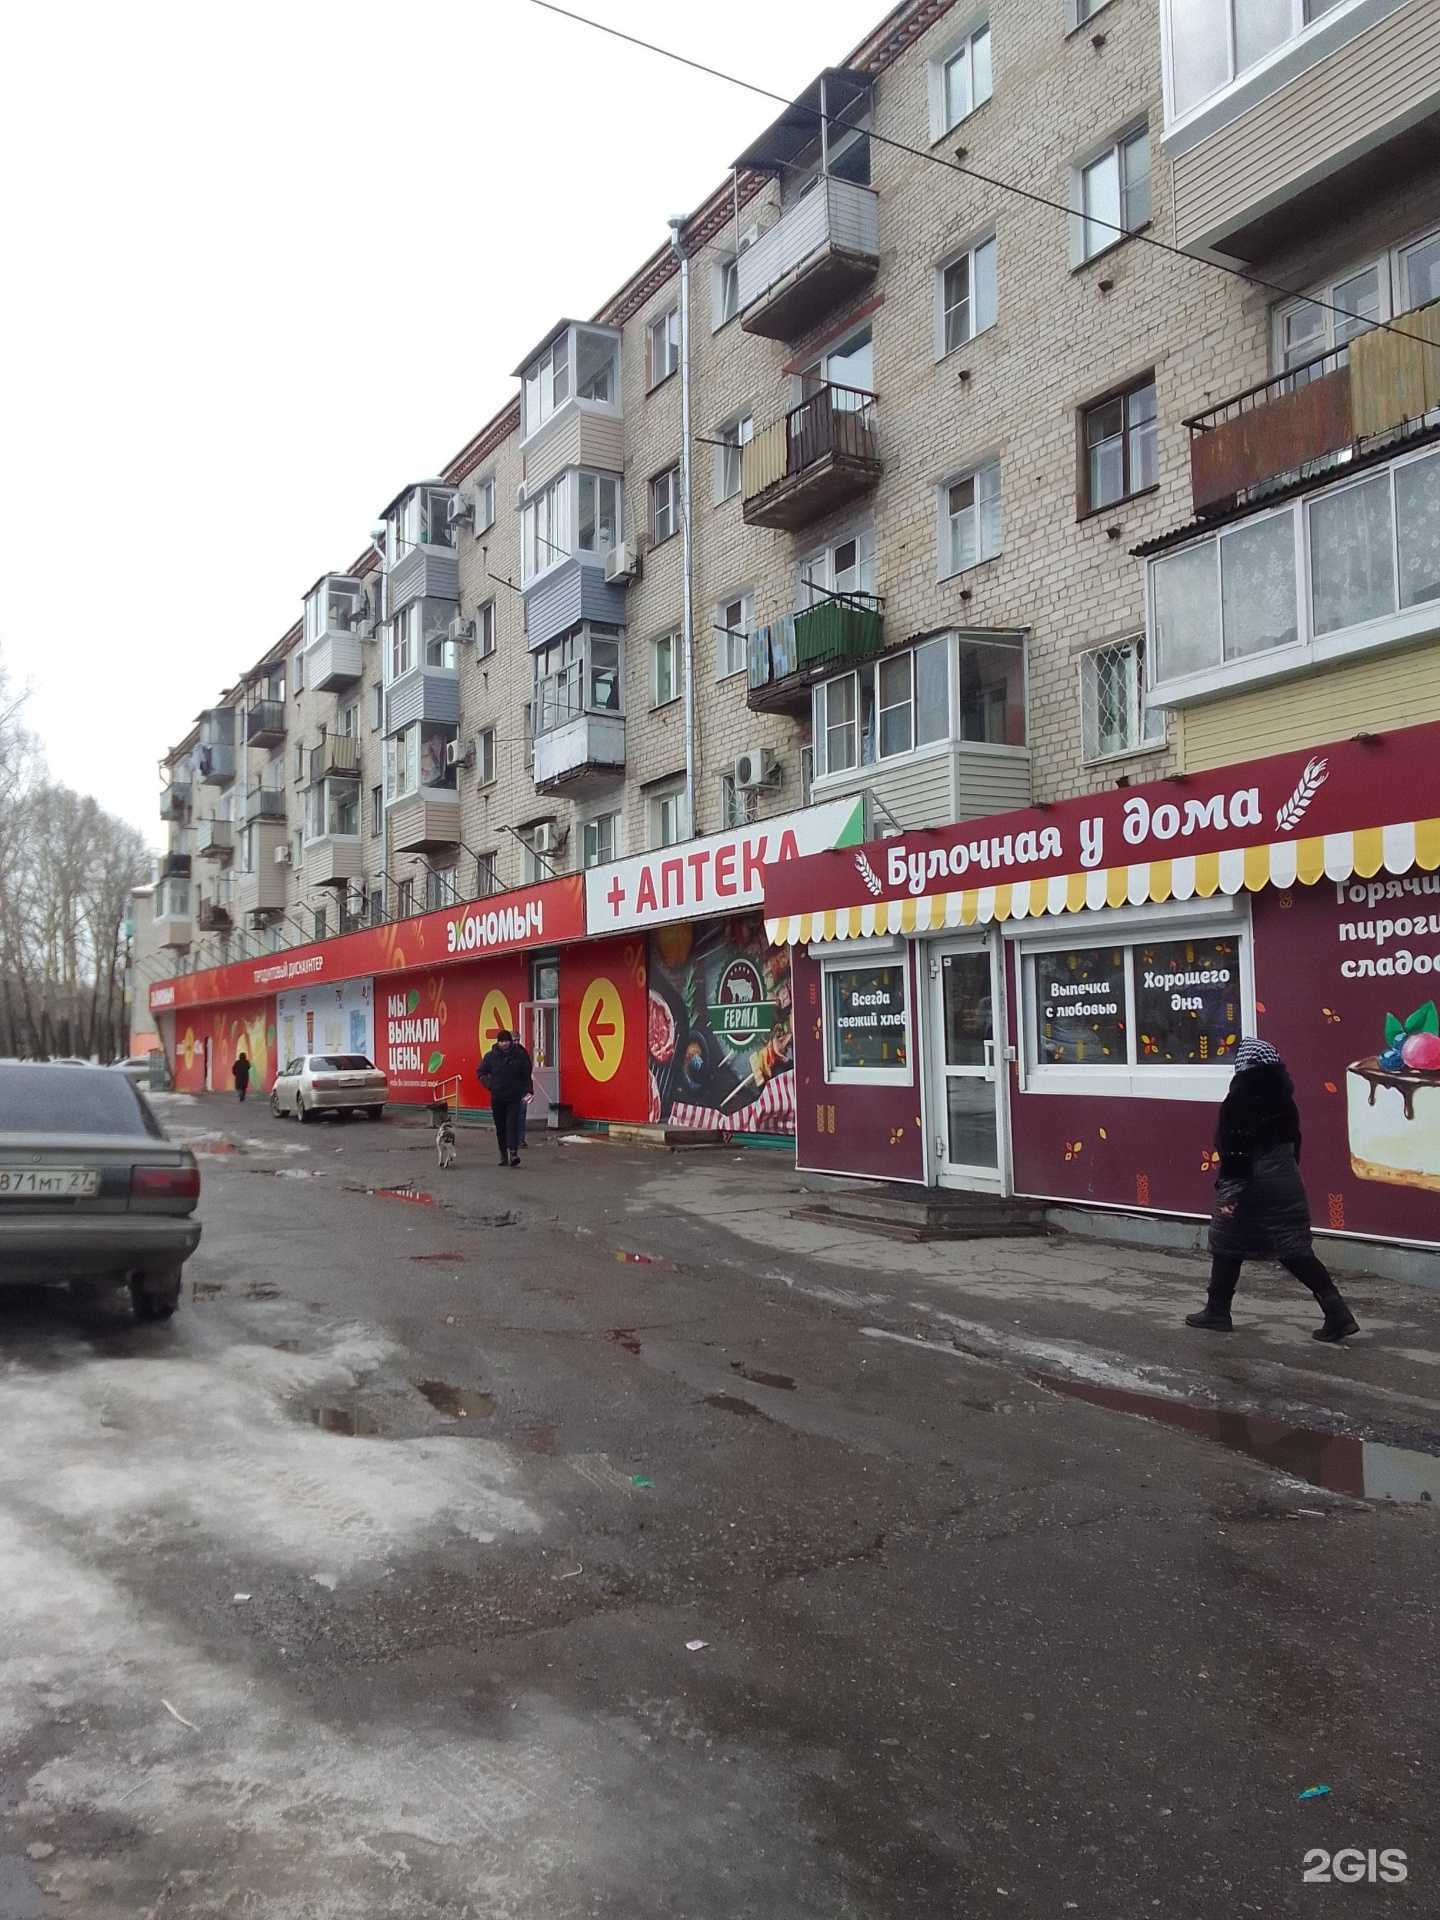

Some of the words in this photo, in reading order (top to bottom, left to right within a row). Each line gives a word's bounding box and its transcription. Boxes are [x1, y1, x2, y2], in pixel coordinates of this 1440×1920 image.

[887, 826, 1062, 895] Булочная
[1079, 816, 1104, 868] у
[1122, 787, 1263, 845] дома
[447, 899, 544, 953] ЭКОНОМЫЧ
[1051, 981, 1111, 997] Выпечка
[1144, 968, 1231, 991] Хорошего
[388, 993, 407, 1018] МЫ
[852, 990, 891, 1006] Всегда
[1171, 993, 1203, 1011] дня
[837, 1012, 878, 1028] свежий
[1046, 1006, 1054, 1018] с
[1057, 1002, 1118, 1017] любовью
[388, 1017, 440, 1044] ВЫЖАЛИ
[389, 1046, 424, 1075] ЦЕНЫ,
